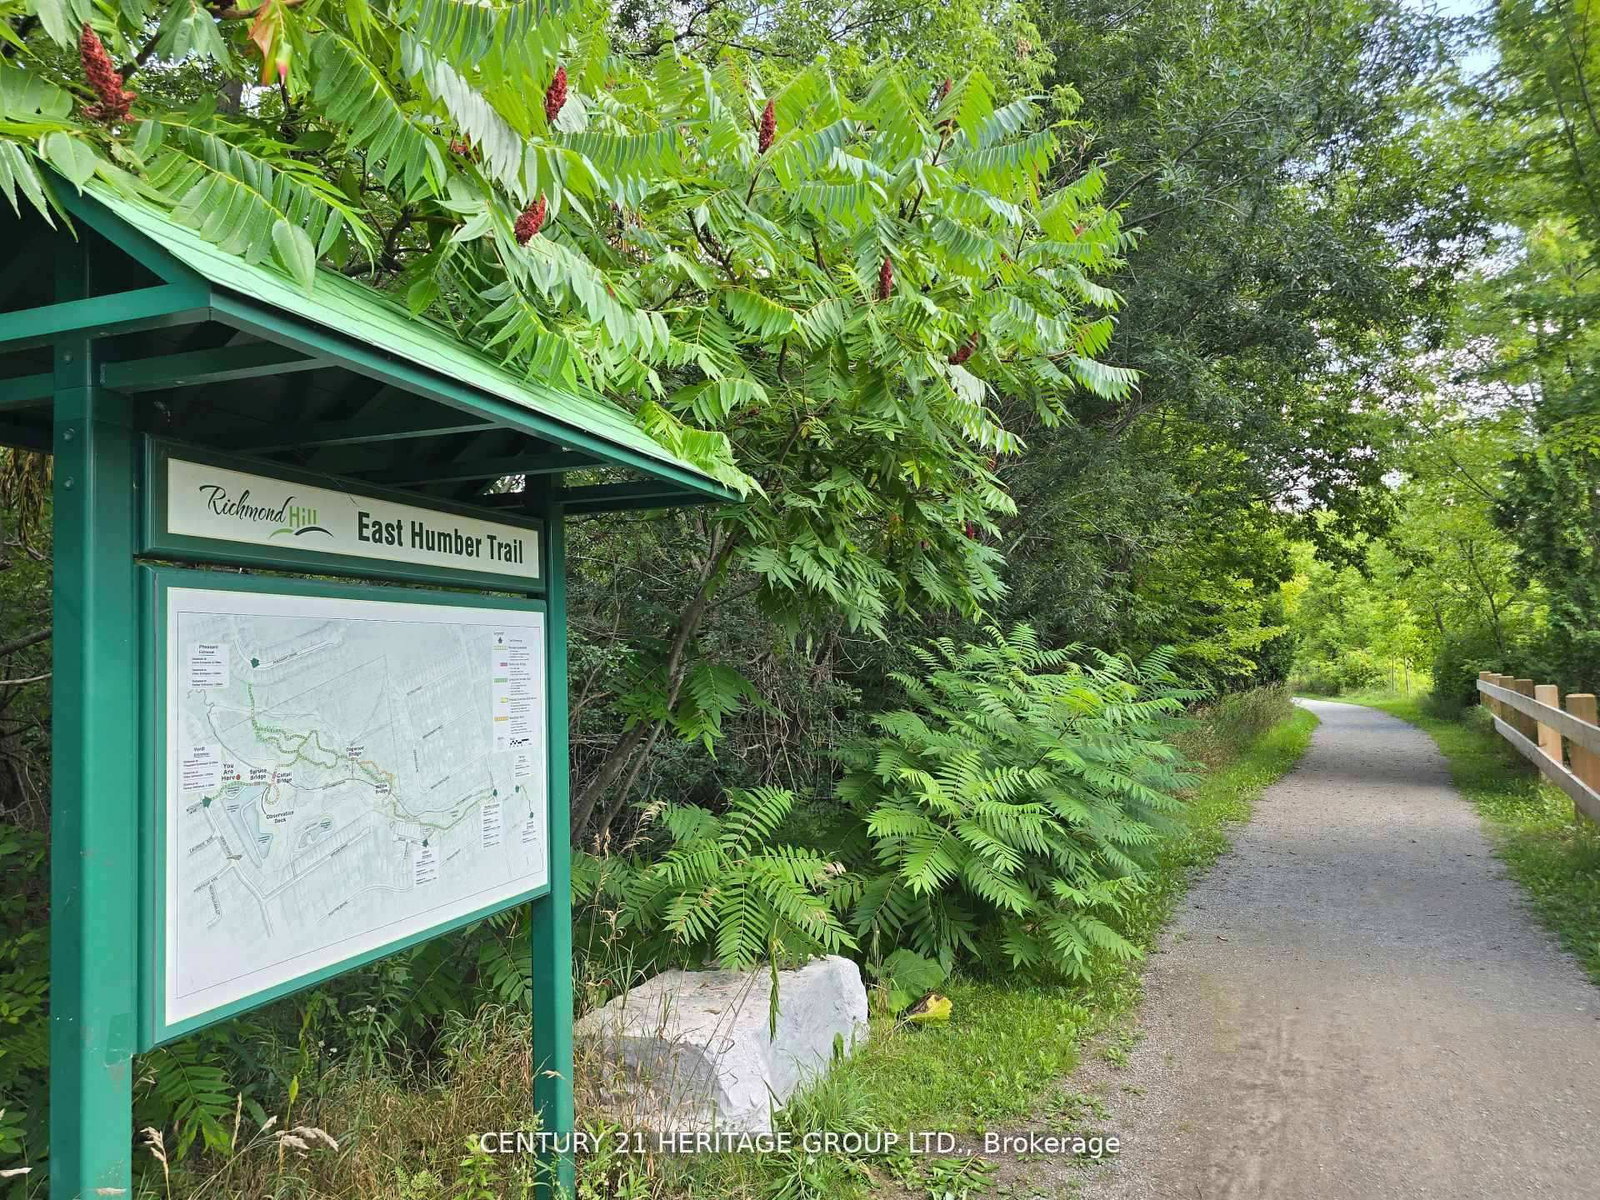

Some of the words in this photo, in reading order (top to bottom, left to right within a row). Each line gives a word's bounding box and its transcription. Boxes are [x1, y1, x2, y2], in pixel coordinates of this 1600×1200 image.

[199, 484, 297, 523] Richmond
[289, 506, 318, 528] Hill
[358, 511, 403, 547] East
[411, 520, 482, 558] Humber
[487, 534, 523, 564] Trail
